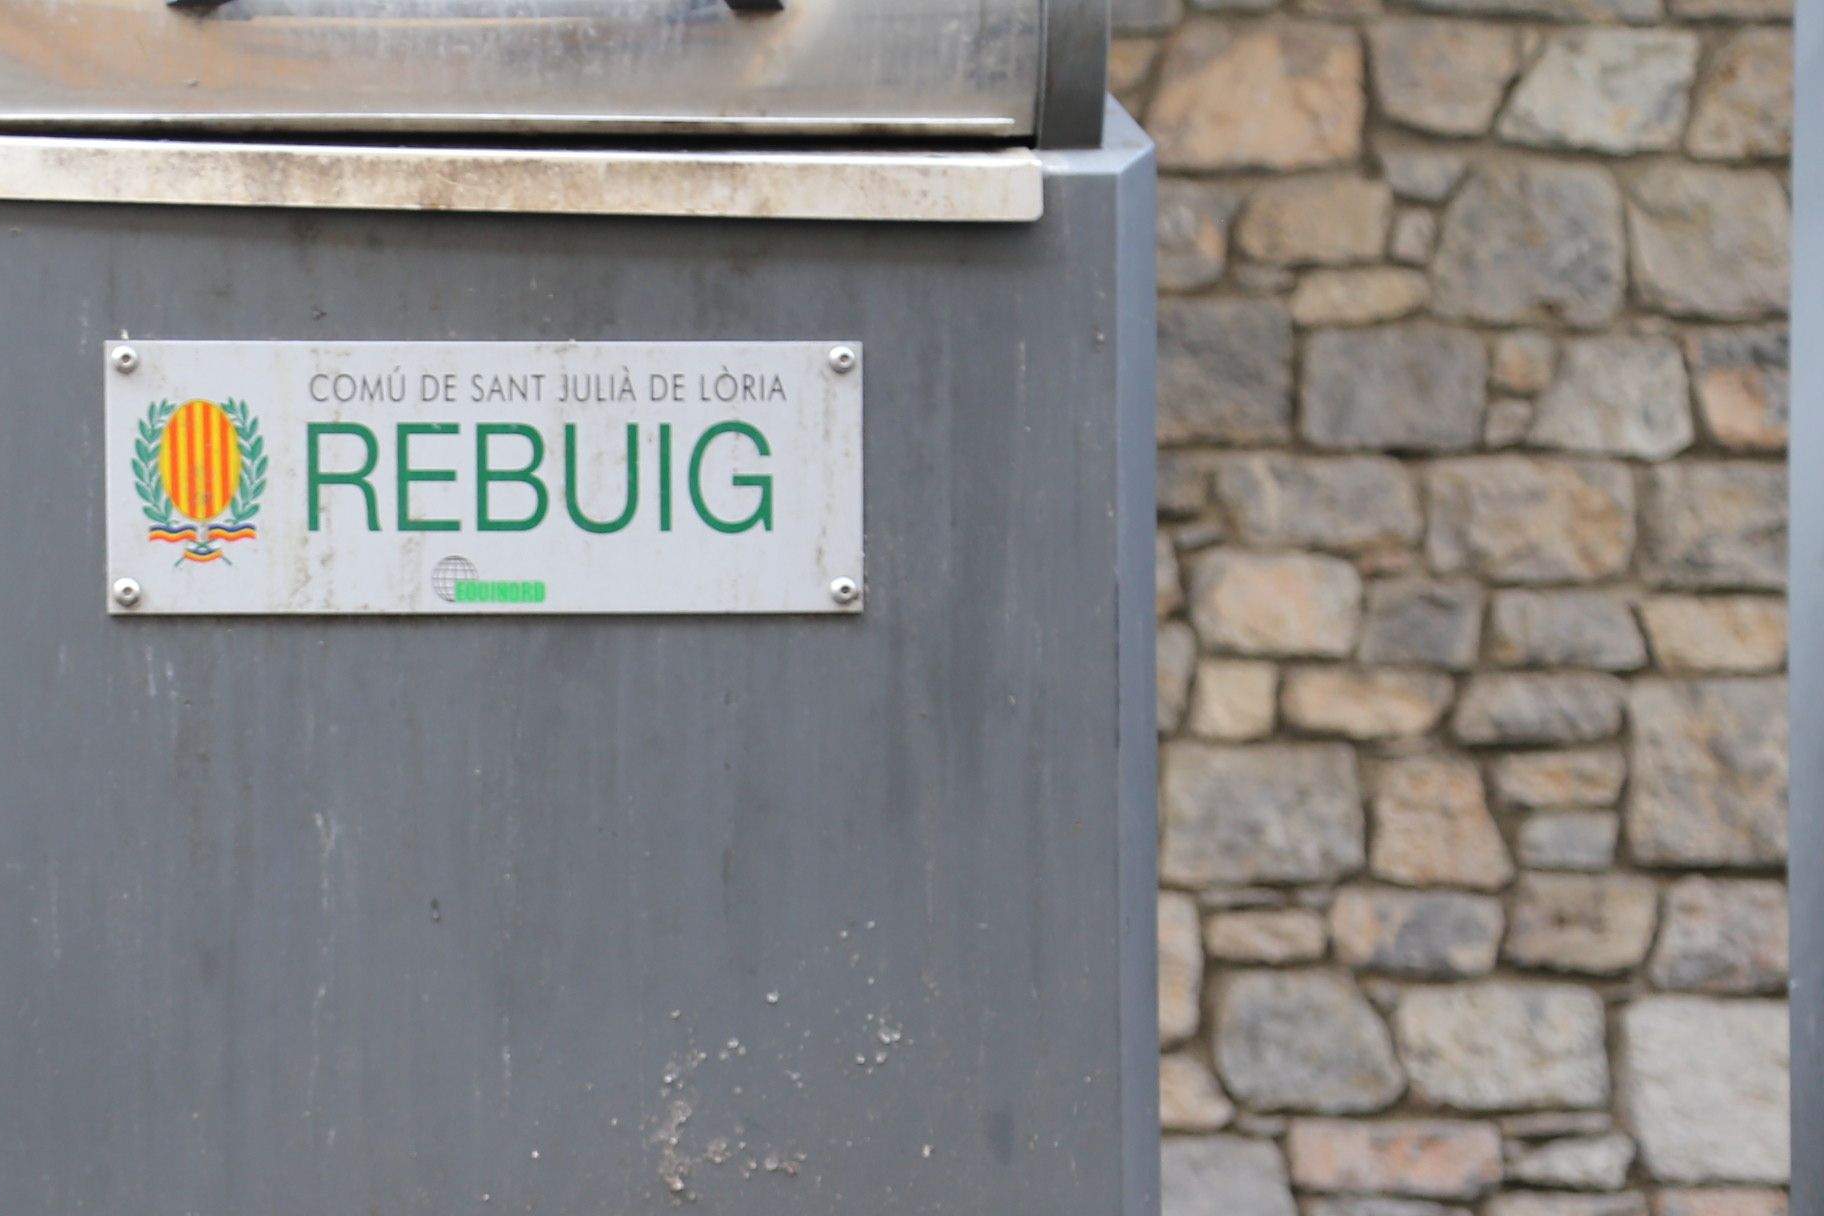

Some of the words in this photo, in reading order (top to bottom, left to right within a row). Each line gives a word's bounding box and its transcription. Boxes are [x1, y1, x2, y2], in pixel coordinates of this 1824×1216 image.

[308, 365, 406, 402] COMÚ
[421, 374, 458, 402] DE
[470, 374, 546, 402] SANT
[558, 365, 637, 402] JULIÀ
[649, 374, 686, 402] DE
[700, 365, 788, 402] LÒRIA
[306, 419, 775, 535] REBUIG
